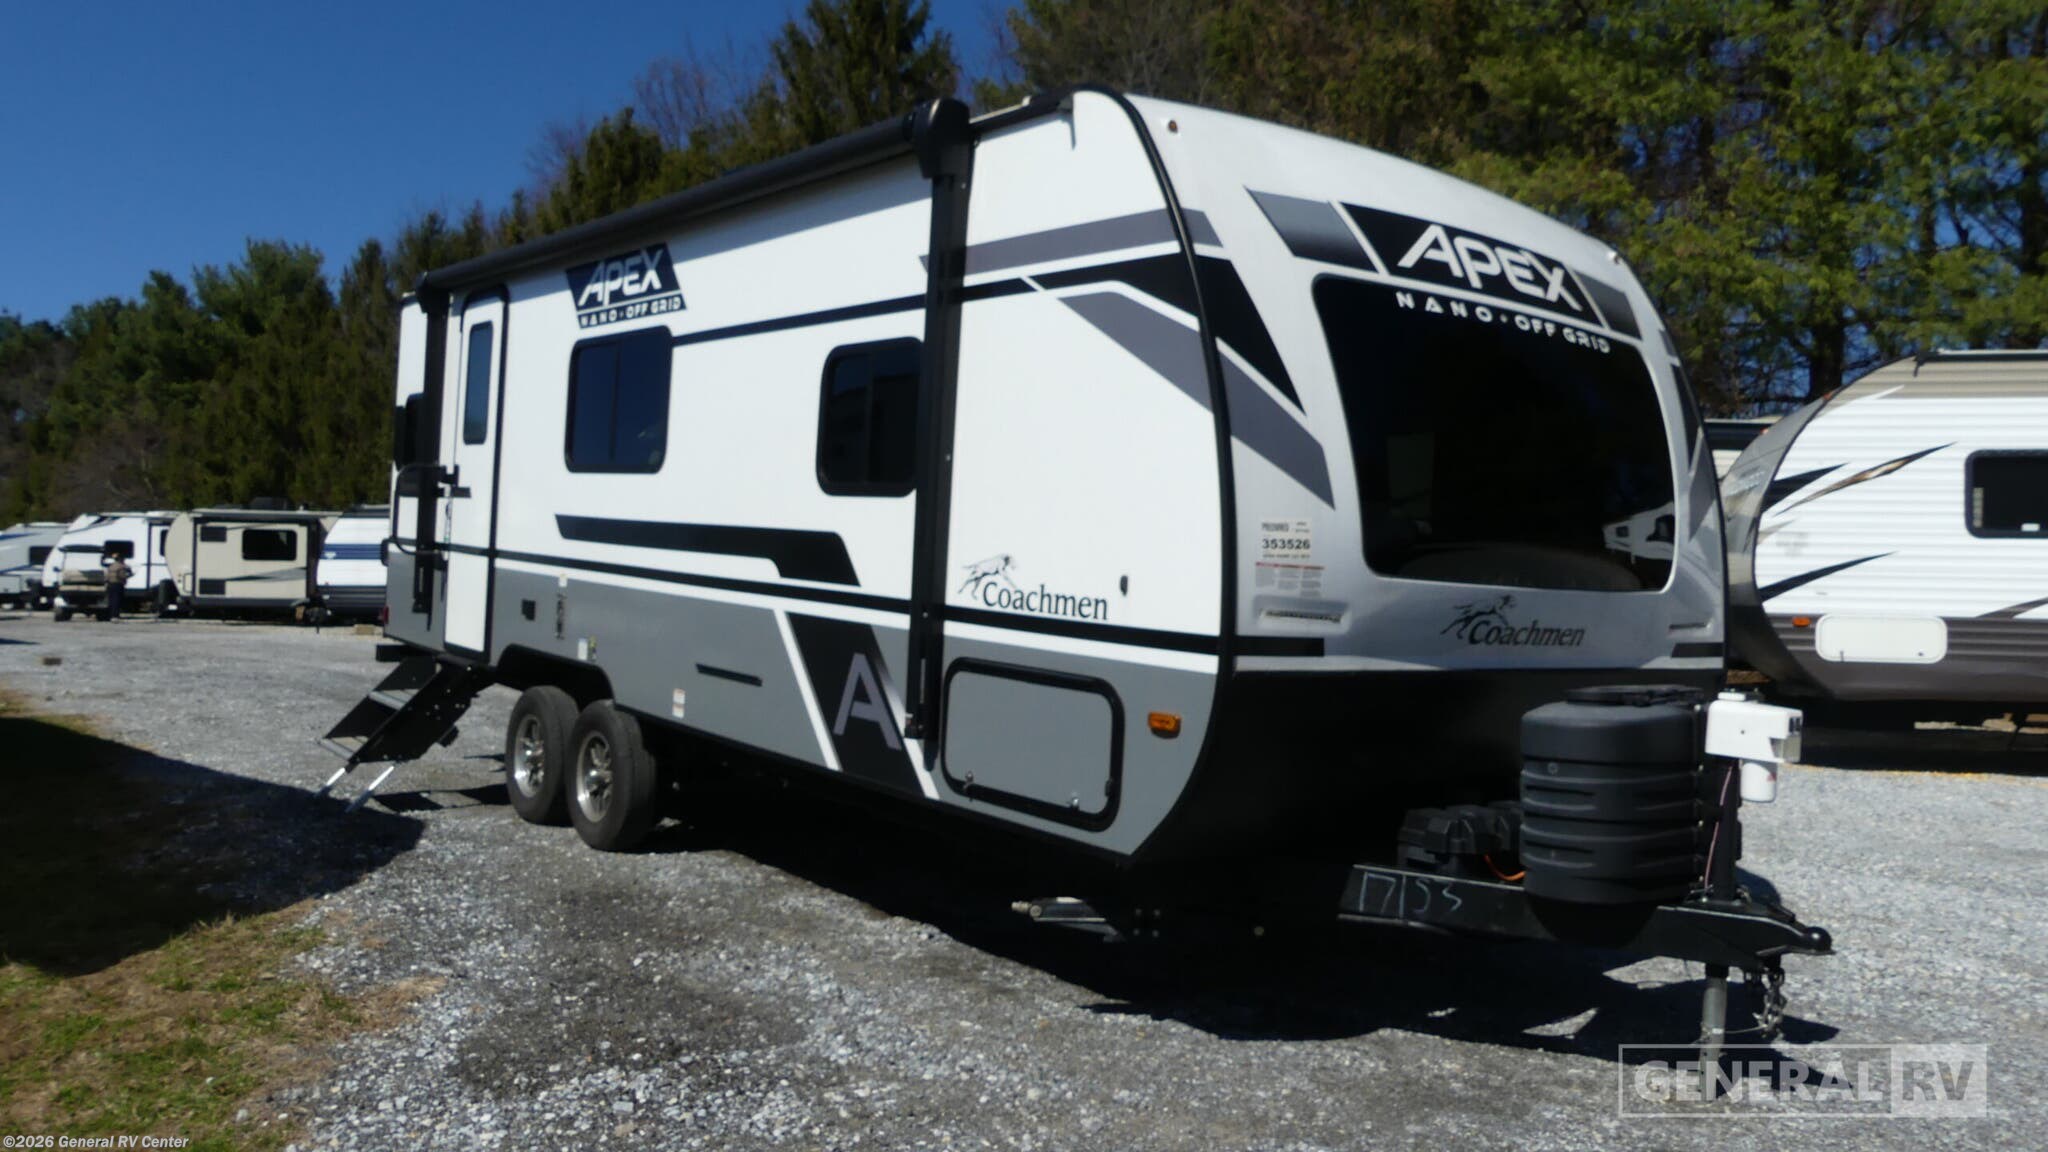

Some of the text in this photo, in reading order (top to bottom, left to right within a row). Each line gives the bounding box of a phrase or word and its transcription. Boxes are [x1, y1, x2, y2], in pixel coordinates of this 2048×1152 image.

[577, 249, 664, 308] APEX
[1397, 223, 1584, 312] APEX
[580, 296, 682, 327] NANO OFF GRID
[1395, 291, 1611, 354] NANO OFF GRID
[1261, 538, 1311, 550] 353526
[982, 581, 1108, 621] Coachmen
[1468, 619, 1586, 647] Coachmen
[833, 652, 903, 751] A
